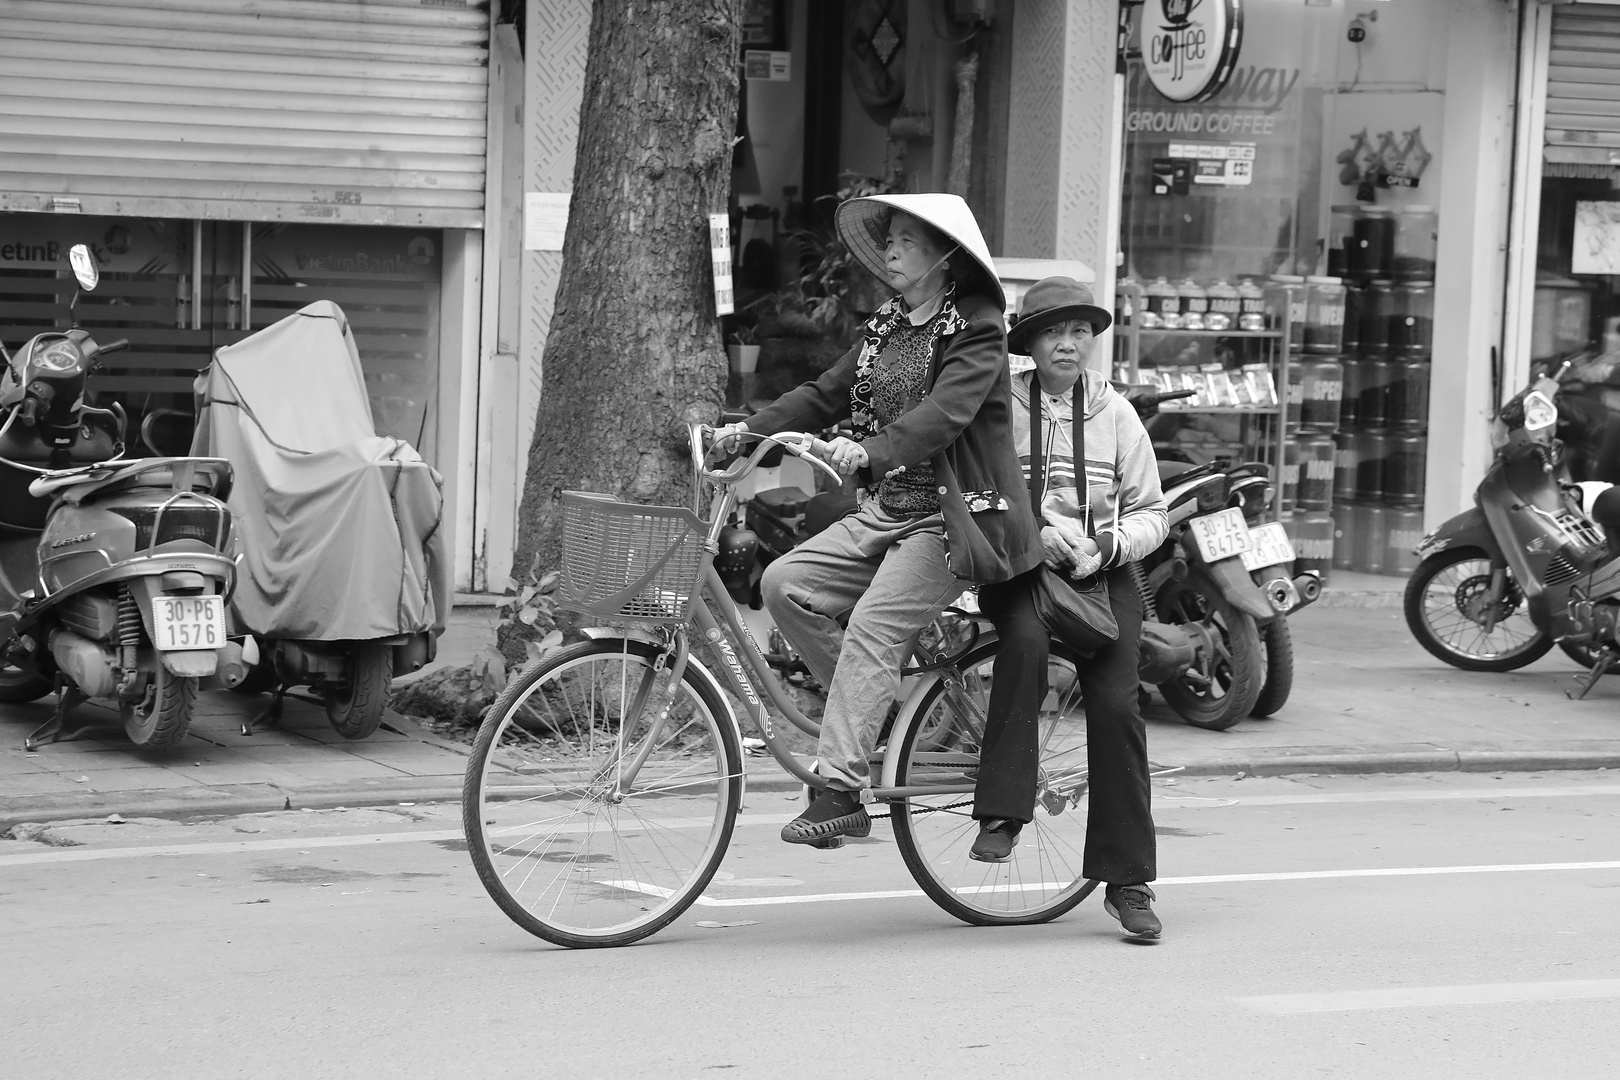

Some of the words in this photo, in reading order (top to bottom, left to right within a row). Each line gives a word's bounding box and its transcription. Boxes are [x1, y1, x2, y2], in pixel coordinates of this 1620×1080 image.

[1127, 111, 1202, 132] GROUND
[1206, 113, 1276, 135] COFFEE
[1207, 532, 1246, 557] 6475
[168, 623, 216, 646] 1576
[718, 638, 759, 706] Wahama
